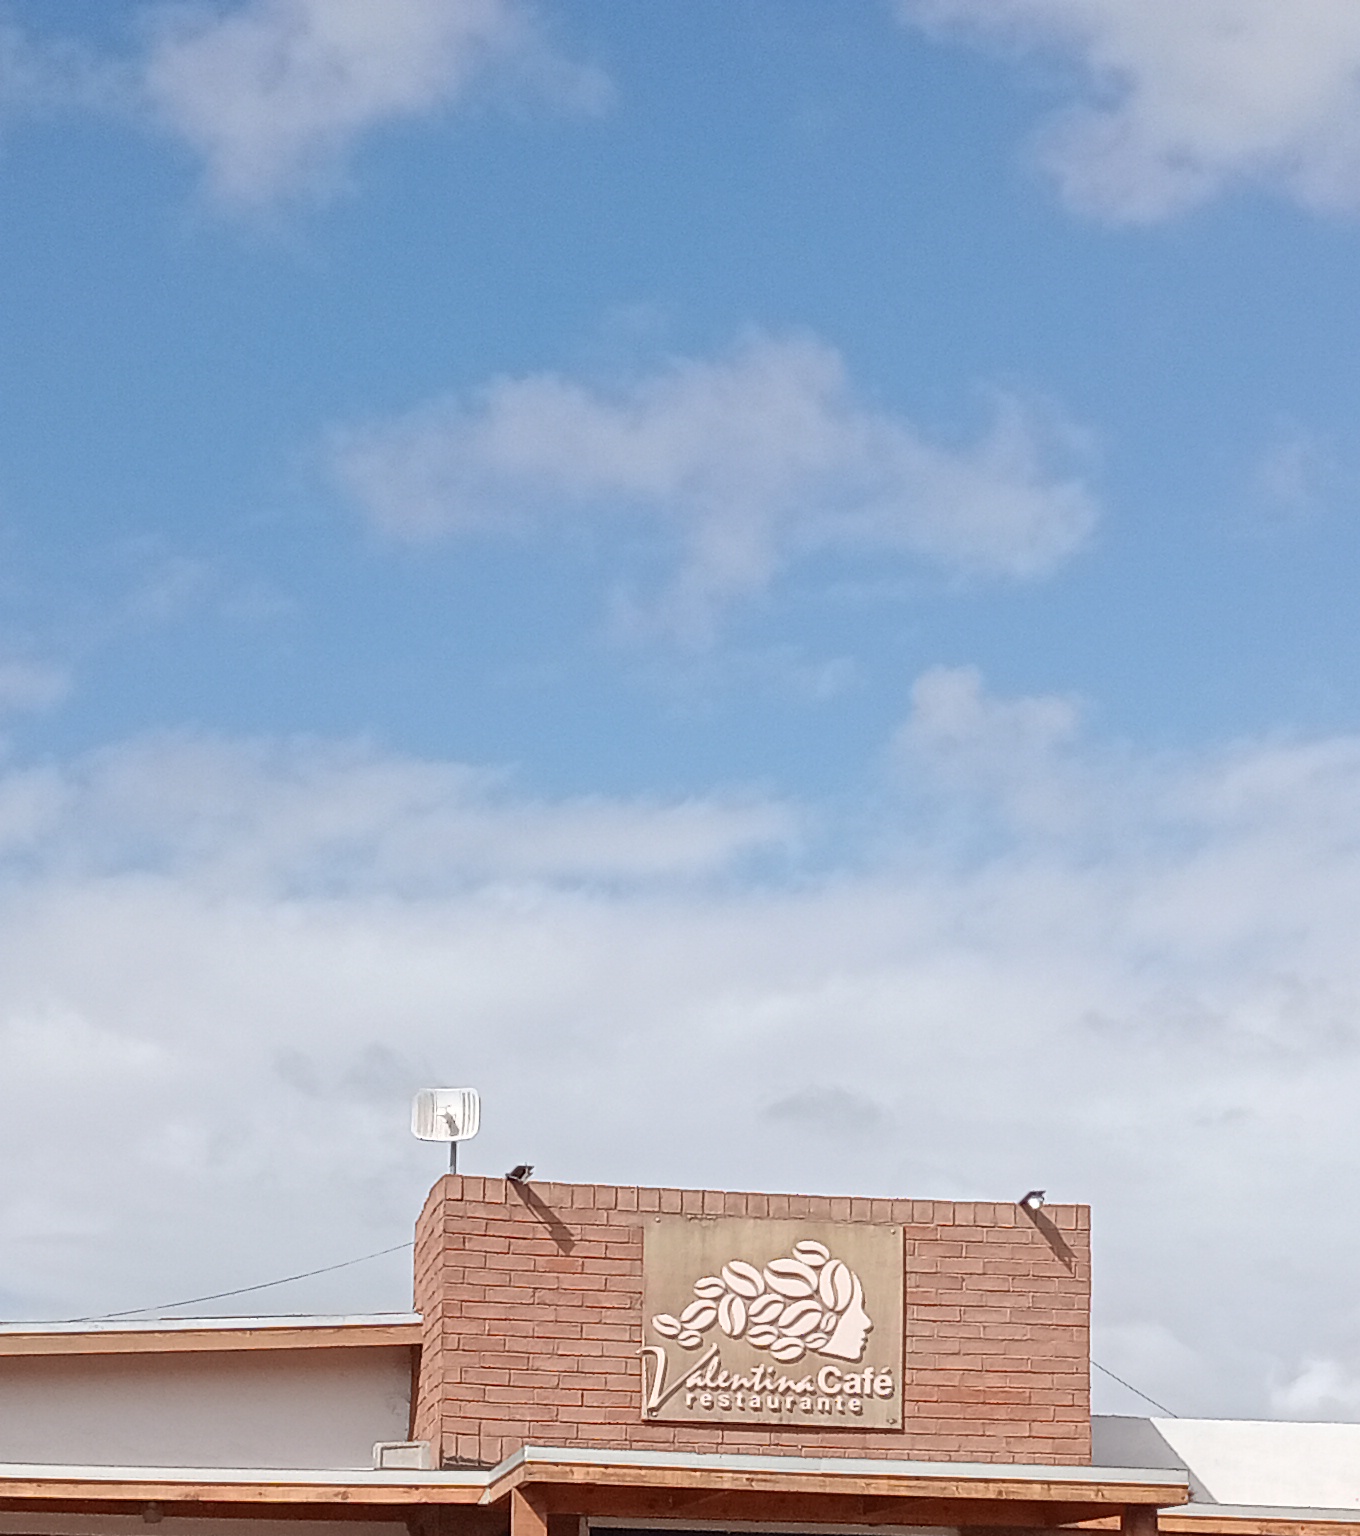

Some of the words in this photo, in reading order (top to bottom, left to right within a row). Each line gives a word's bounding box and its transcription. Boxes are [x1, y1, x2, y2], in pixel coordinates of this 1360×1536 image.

[635, 1342, 816, 1412] Valentina
[817, 1365, 893, 1397] Café
[685, 1391, 863, 1416] restaurante
